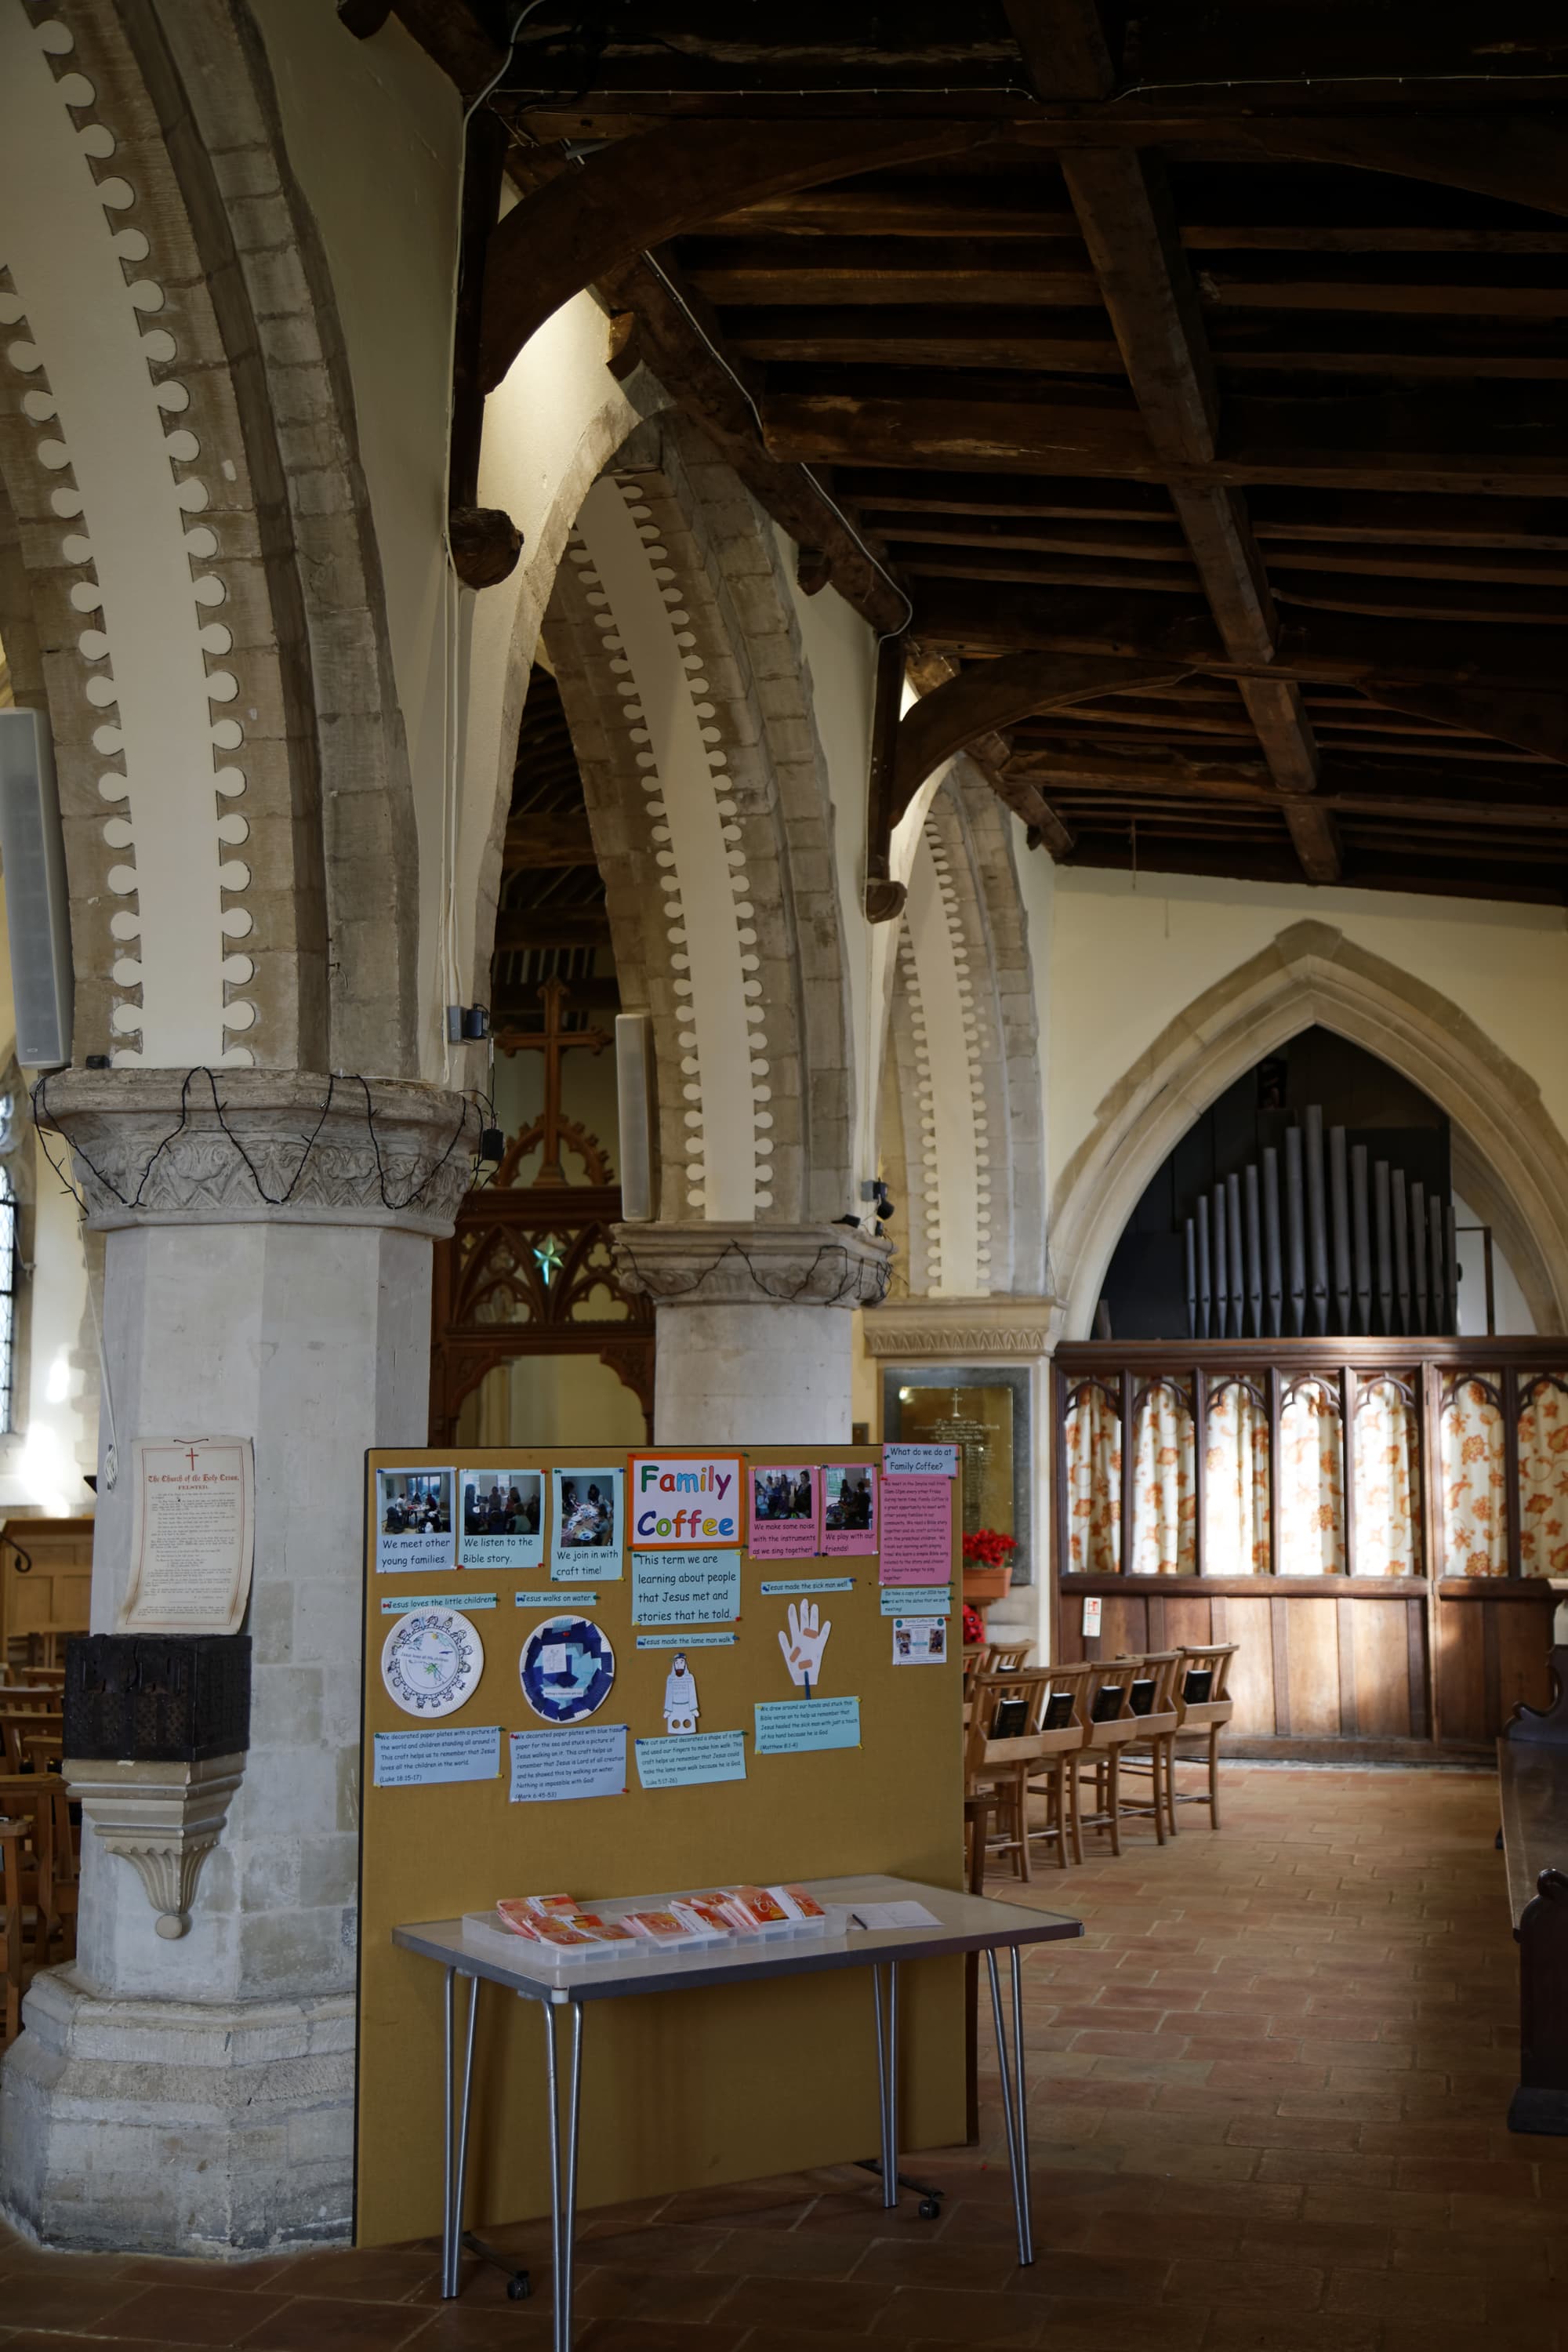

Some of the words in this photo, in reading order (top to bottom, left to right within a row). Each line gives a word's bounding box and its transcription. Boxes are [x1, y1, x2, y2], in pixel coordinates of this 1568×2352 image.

[891, 1462, 913, 1472] Family
[641, 1465, 731, 1501] Family
[637, 1509, 734, 1537] Coffee
[464, 1538, 477, 1547] We
[481, 1538, 503, 1547] listen
[506, 1537, 515, 1546] to
[520, 1537, 532, 1546] the
[573, 1551, 588, 1561] join
[772, 1548, 783, 1556] sing
[382, 1556, 407, 1567] young
[411, 1554, 446, 1564] families.
[487, 1555, 512, 1565] story.
[639, 1555, 659, 1565] This
[662, 1555, 684, 1564] term
[557, 1567, 579, 1576] craft
[583, 1566, 601, 1575] time!
[638, 1573, 676, 1585] learning
[679, 1573, 704, 1583] about
[708, 1571, 736, 1584] people
[638, 1593, 658, 1602] that
[662, 1592, 689, 1602] Jesus
[693, 1592, 709, 1600] met
[713, 1591, 728, 1600] and
[637, 1613, 670, 1622] stories
[675, 1611, 695, 1621] that
[699, 1610, 709, 1619] he
[712, 1609, 731, 1618] told.
